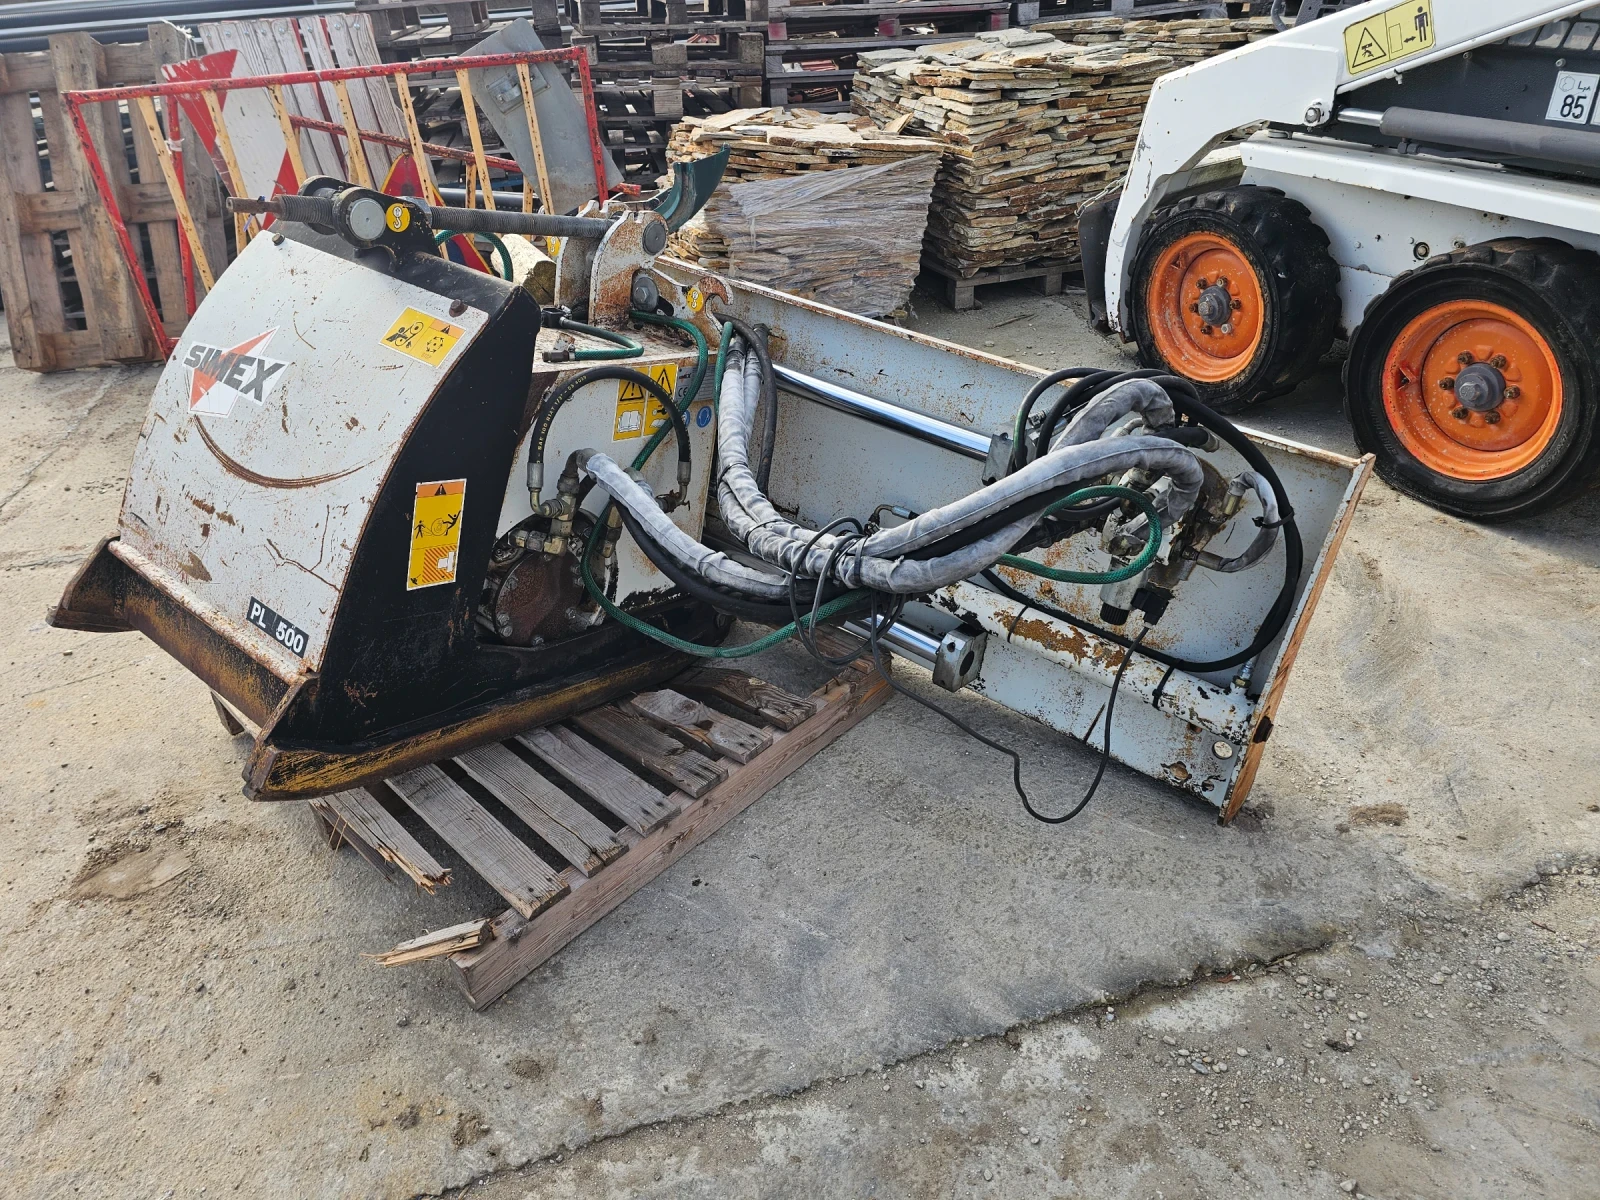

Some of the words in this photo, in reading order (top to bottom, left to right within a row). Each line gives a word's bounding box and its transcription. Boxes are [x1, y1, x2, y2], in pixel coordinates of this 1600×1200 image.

[1560, 94, 1587, 119] 85
[183, 344, 286, 402] SIMEX
[250, 602, 266, 629] PL
[275, 620, 304, 653] 500
